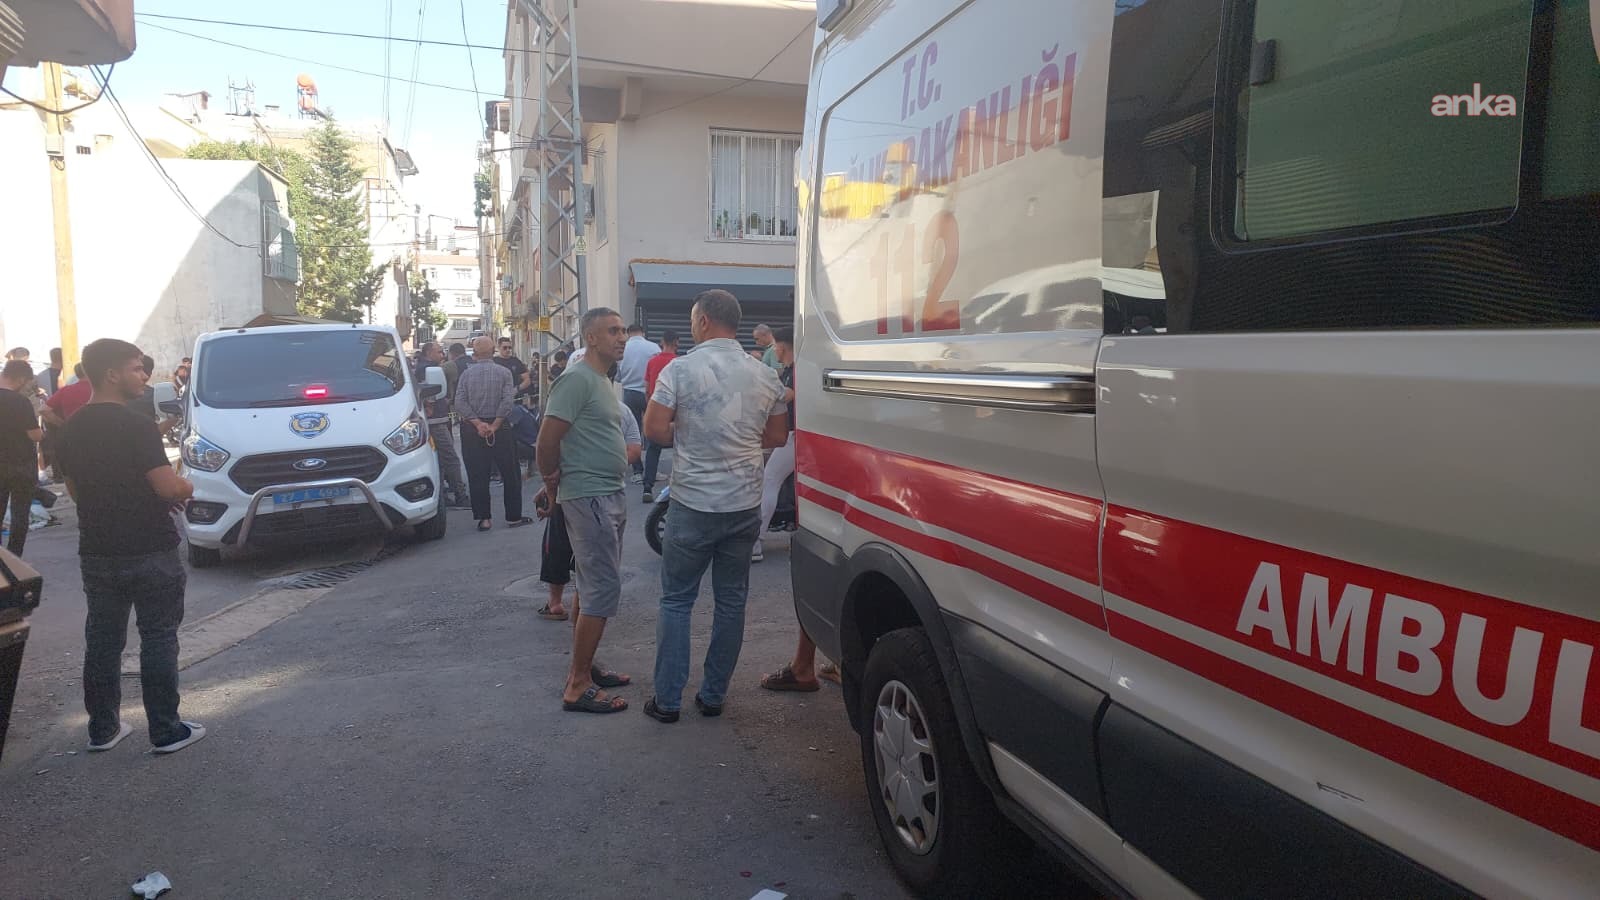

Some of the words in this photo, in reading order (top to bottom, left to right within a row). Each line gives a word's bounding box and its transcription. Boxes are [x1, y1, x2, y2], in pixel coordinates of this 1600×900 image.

[901, 41, 941, 121] T.C.
[901, 43, 1077, 190] BAKANLIĞI
[872, 210, 960, 335] 112
[1236, 561, 1600, 760] AMBUL
